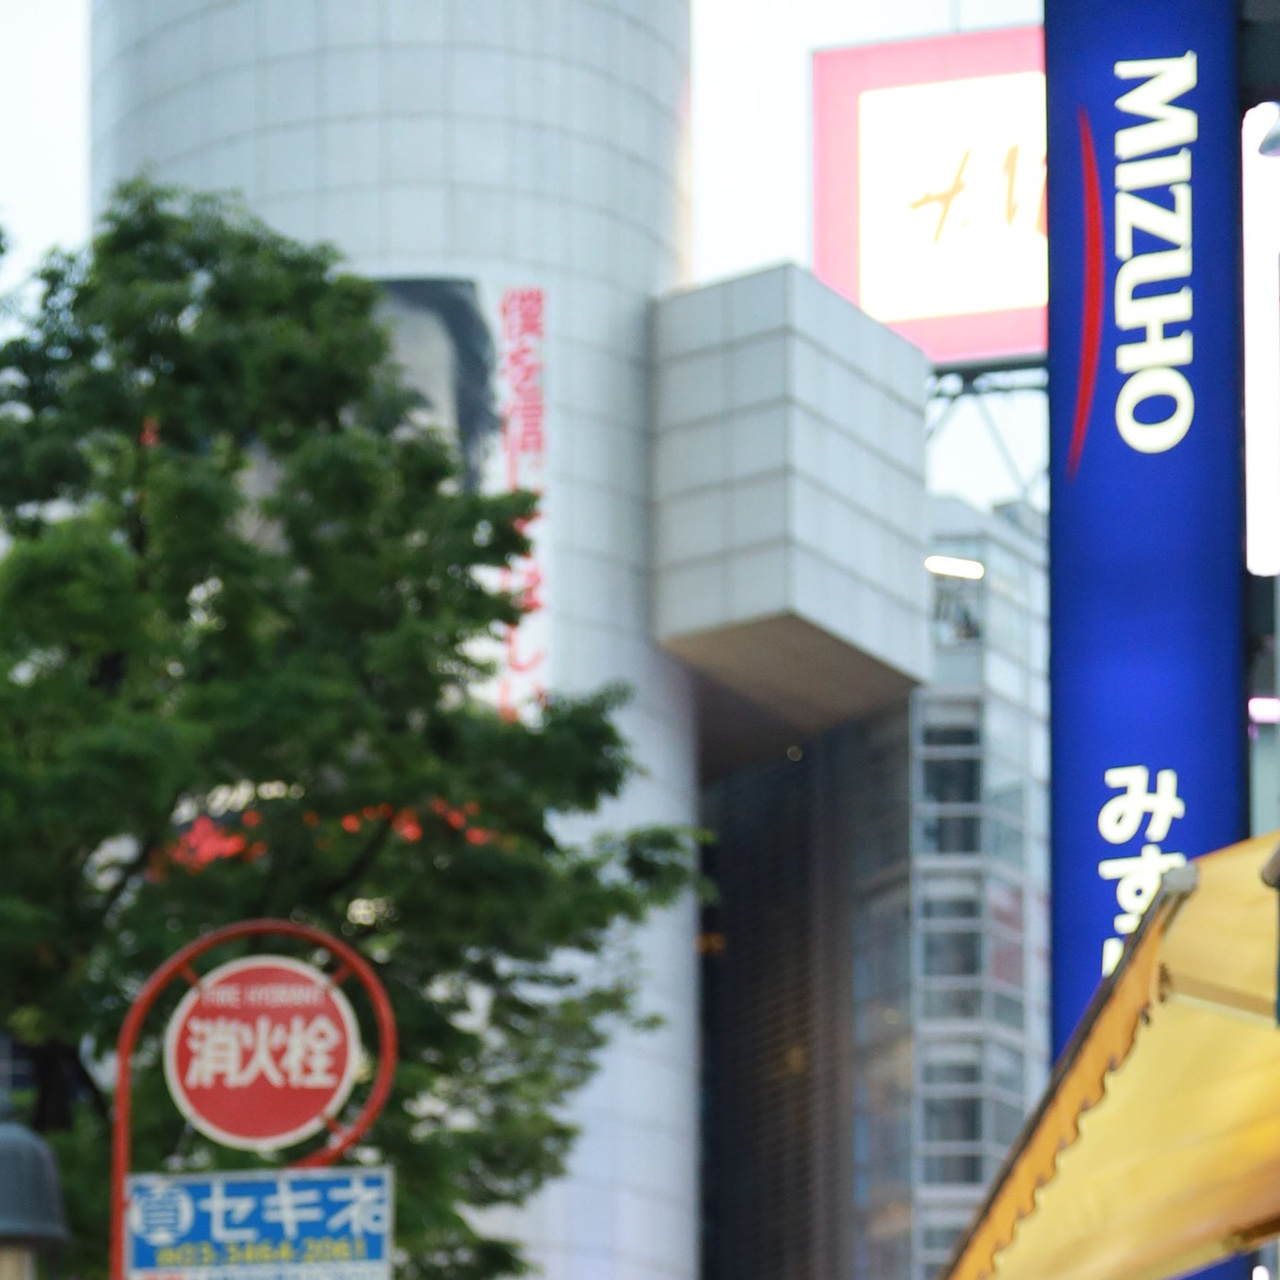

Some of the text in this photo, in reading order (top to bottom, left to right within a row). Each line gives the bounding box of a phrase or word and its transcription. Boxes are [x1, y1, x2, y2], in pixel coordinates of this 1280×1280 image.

[1114, 50, 1198, 454] MIZUHO
[1097, 764, 1187, 977] みず
[185, 1015, 340, 1088] 消火栓
[199, 1176, 386, 1243] セキネ
